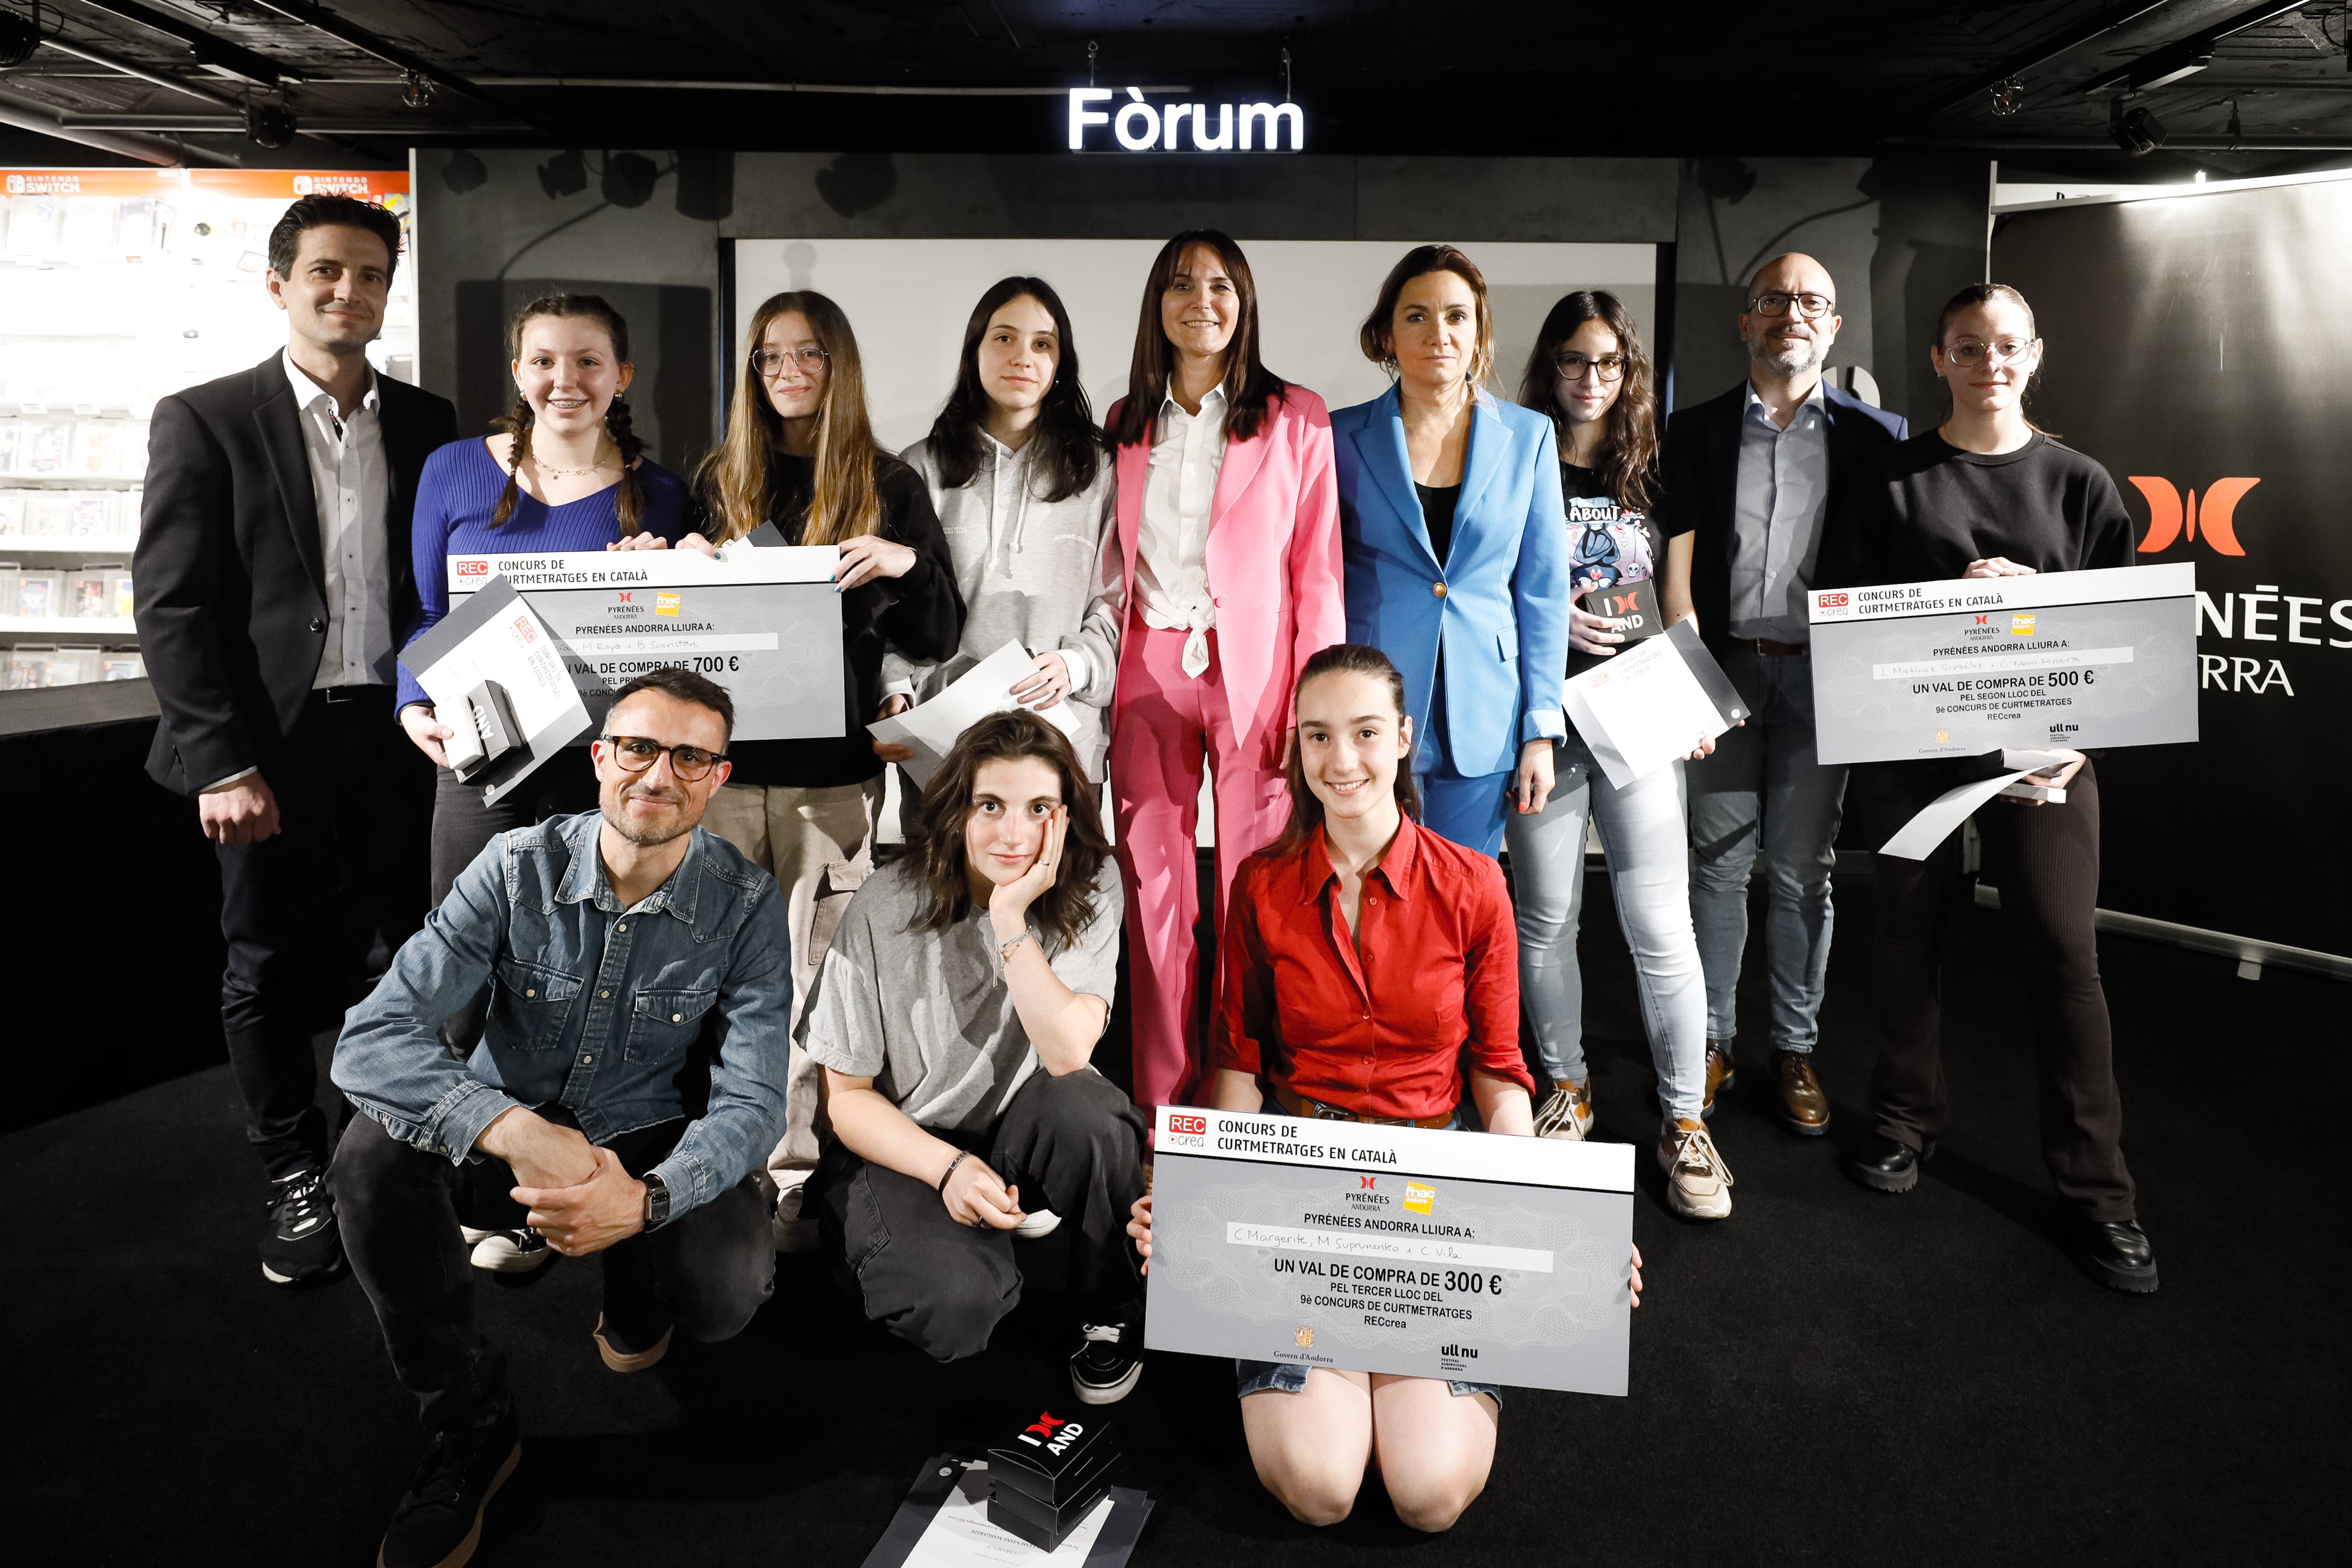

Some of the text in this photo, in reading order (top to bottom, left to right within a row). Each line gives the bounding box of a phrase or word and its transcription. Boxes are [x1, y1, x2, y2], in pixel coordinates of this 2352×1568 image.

[1069, 86, 1304, 150] Fòrum
[26, 182, 81, 193] SWITCH
[313, 183, 369, 194] SWITCH
[1569, 506, 1621, 522] ABOUT
[458, 563, 488, 574] REC
[498, 560, 565, 570] CONCURS DE
[465, 577, 488, 585] crea
[504, 569, 648, 584] URTMETRATGES EN CATALÀ
[1820, 594, 1848, 606] REC
[1858, 588, 1922, 602] CONCURS DE
[1603, 597, 1613, 617] I
[1859, 593, 2003, 614] CURTMETRATGES EN CATALÀ
[1827, 607, 1848, 616] crea
[575, 622, 715, 635] PYRÉNÉES ANDORRA LLIURA A:
[1610, 614, 1644, 634] AND
[2012, 617, 2035, 625] fnac
[516, 617, 537, 643] REC
[511, 630, 527, 649] crea
[597, 643, 621, 653] Rayo
[637, 641, 645, 649] B
[1933, 644, 1979, 657] PYRÉNÉES
[1981, 643, 2025, 653] ANDORRA
[2027, 640, 2059, 650] LLIURA
[527, 656, 535, 666] EN
[540, 645, 563, 682] CONCURS DE
[574, 663, 597, 674] VAL
[601, 662, 616, 673] DE
[619, 660, 670, 673] COMPRA
[674, 660, 689, 671] DE
[693, 656, 724, 673] 700
[728, 656, 740, 671] €
[1614, 653, 1638, 670] CONCURS
[534, 650, 561, 700] CURTMETRATGES
[1590, 672, 1611, 687] REC
[1882, 667, 1889, 677] L
[1912, 670, 2094, 694] UN VAL DE COMPRA DE 500 €
[1977, 692, 2006, 700] SEGON
[2008, 690, 2029, 698] LLOC
[1947, 703, 1987, 713] CONCURS
[2001, 697, 2072, 710] CURTMETRATGES
[474, 705, 494, 739] AND
[2049, 723, 2064, 733] ull
[1171, 1116, 1205, 1132] REC
[1218, 1120, 1298, 1138] CONCURS DE
[1178, 1135, 1204, 1147] crea
[1217, 1137, 1397, 1164] CURTMETRATGES EN CATALÀ
[1406, 1186, 1435, 1198] fnac
[1351, 1203, 1381, 1212] ANDORRA
[1303, 1213, 1476, 1239] PYRÉNÉES ANDORRA LLIURA A:
[1234, 1229, 1244, 1240] C
[1318, 1235, 1330, 1246] M
[1420, 1246, 1430, 1256] C
[1436, 1246, 1463, 1259] Vila
[1274, 1258, 1502, 1295] UN VAL DE COMPRA DE 300 €
[1330, 1283, 1443, 1302] PEL TERCER LLOC DEL
[1300, 1295, 1472, 1320] 9è CONCURS DE CURTMETRATGES
[1364, 1315, 1407, 1329] RECcrea
[1273, 1350, 1333, 1363] Govern d'Andorra
[1441, 1344, 1478, 1358] ull nu
[1017, 1434, 1042, 1447] I
[1046, 1423, 1083, 1456] AND
